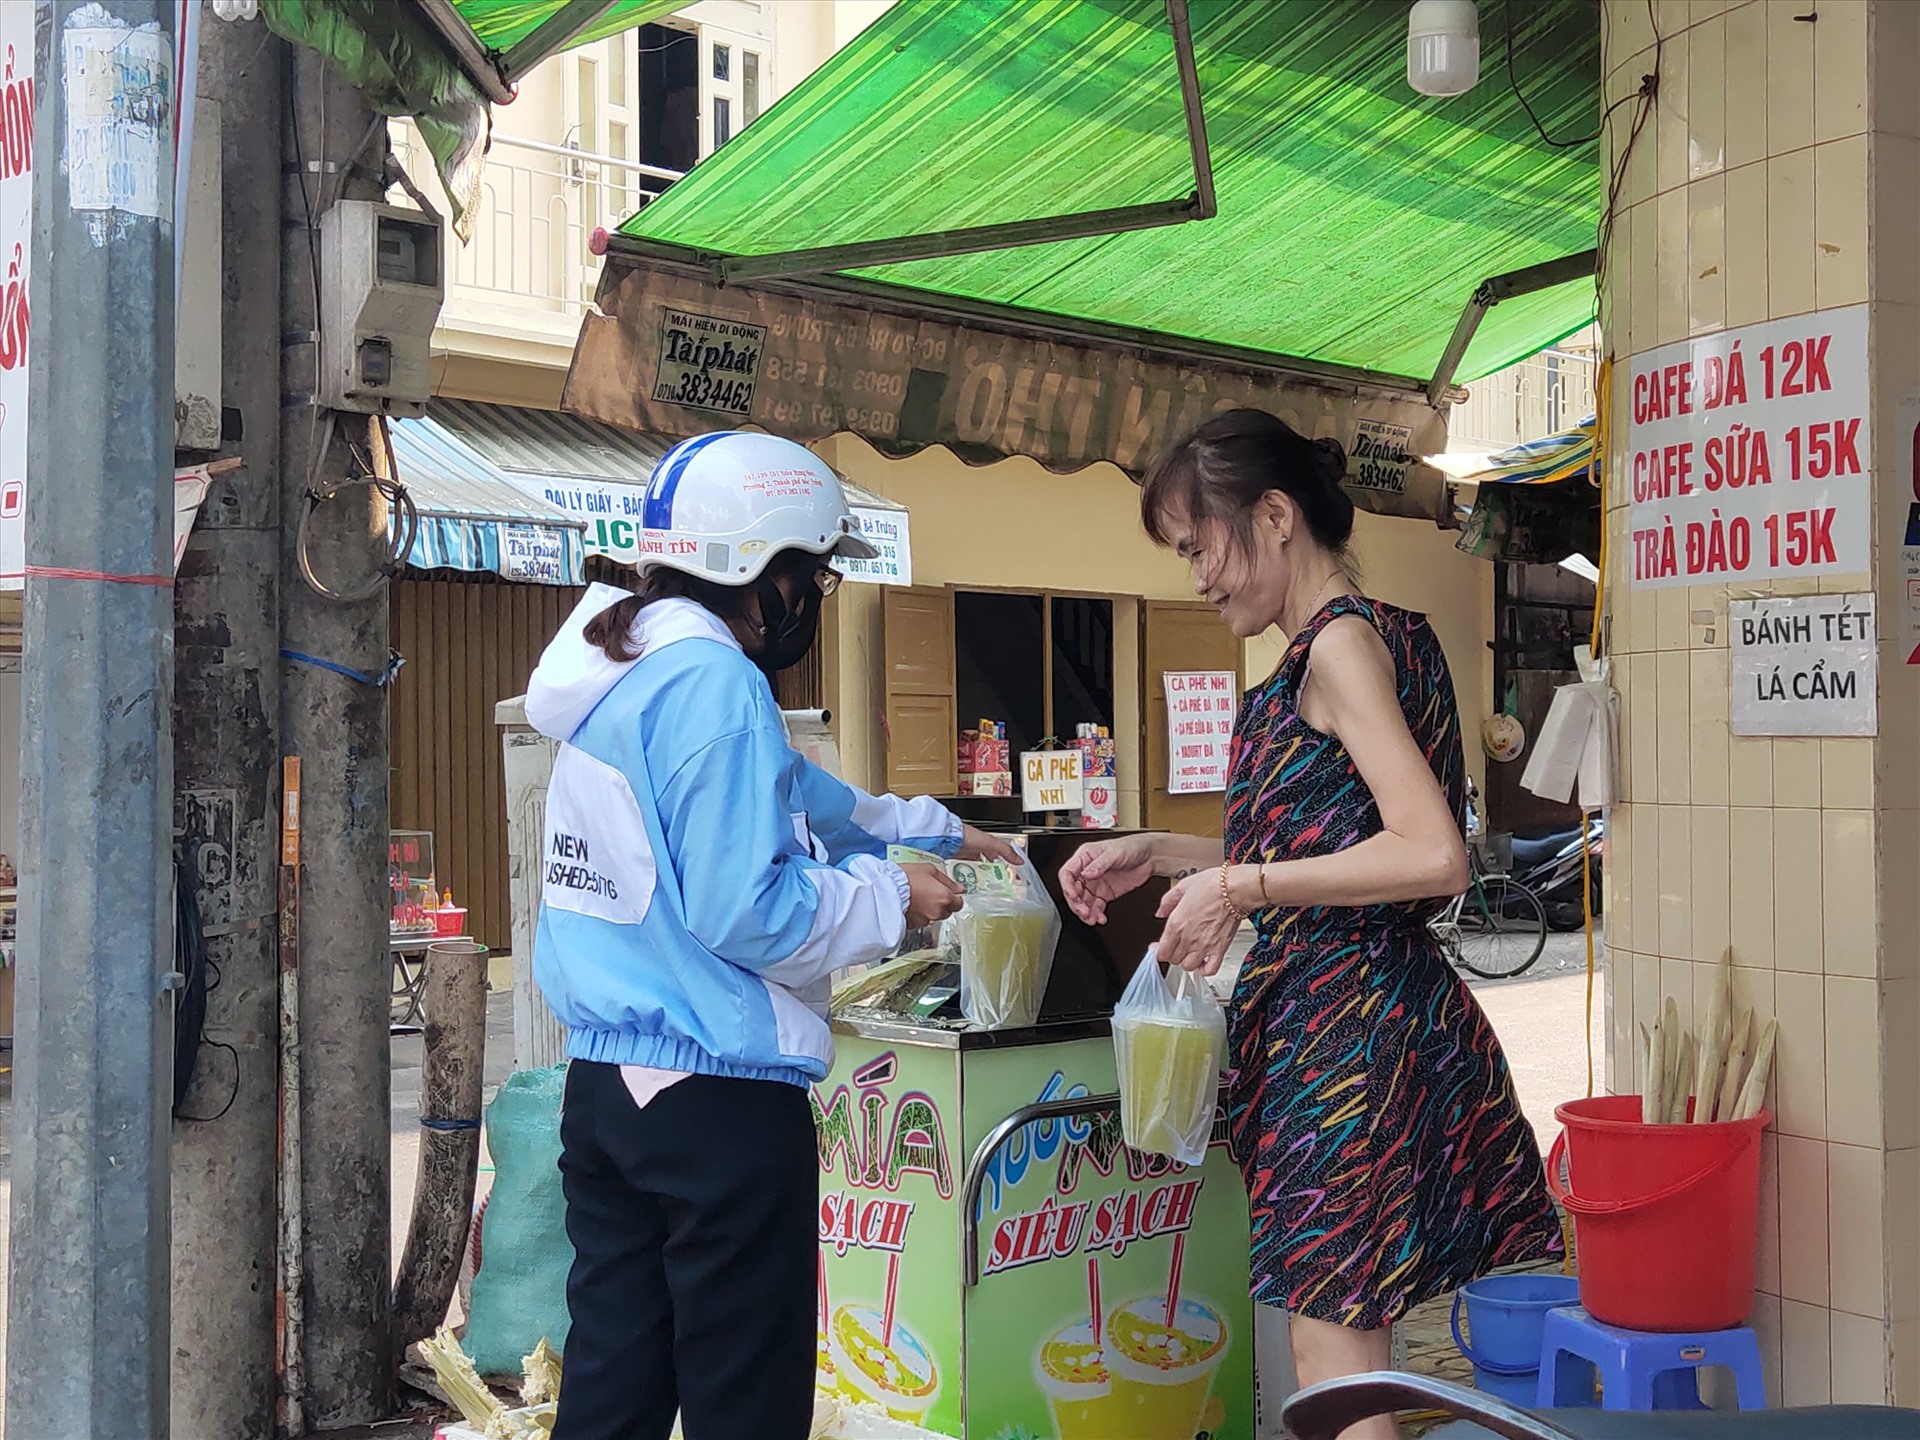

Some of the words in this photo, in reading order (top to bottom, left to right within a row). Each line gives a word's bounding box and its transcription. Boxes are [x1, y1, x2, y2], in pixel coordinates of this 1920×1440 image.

[670, 314, 693, 328] MÁI
[694, 318, 717, 334] HIÊN
[718, 323, 731, 335] DI
[1633, 361, 1694, 426] CAFE
[1703, 340, 1748, 411] ĐÁ
[1759, 335, 1832, 400] 12K
[1633, 441, 1694, 504] CAFE
[1704, 423, 1771, 492] SỮA
[1785, 418, 1861, 481] 15K
[568, 487, 583, 511] LÝ
[586, 488, 612, 514] GIẤY
[667, 538, 698, 554] TÍN
[1633, 515, 1678, 581] TRÀ
[1685, 508, 1750, 575] ĐÀO
[1764, 507, 1837, 567] 15K
[1742, 611, 1811, 646] BÁNH
[1757, 670, 1786, 701] LÁ
[1792, 663, 1857, 700] CẨM
[1050, 753, 1079, 781] PHÊ
[552, 832, 589, 862] NEW
[819, 1191, 916, 1258] SẠCH
[983, 1194, 1093, 1277] SIÊU
[1083, 1177, 1205, 1258] SẠCH
